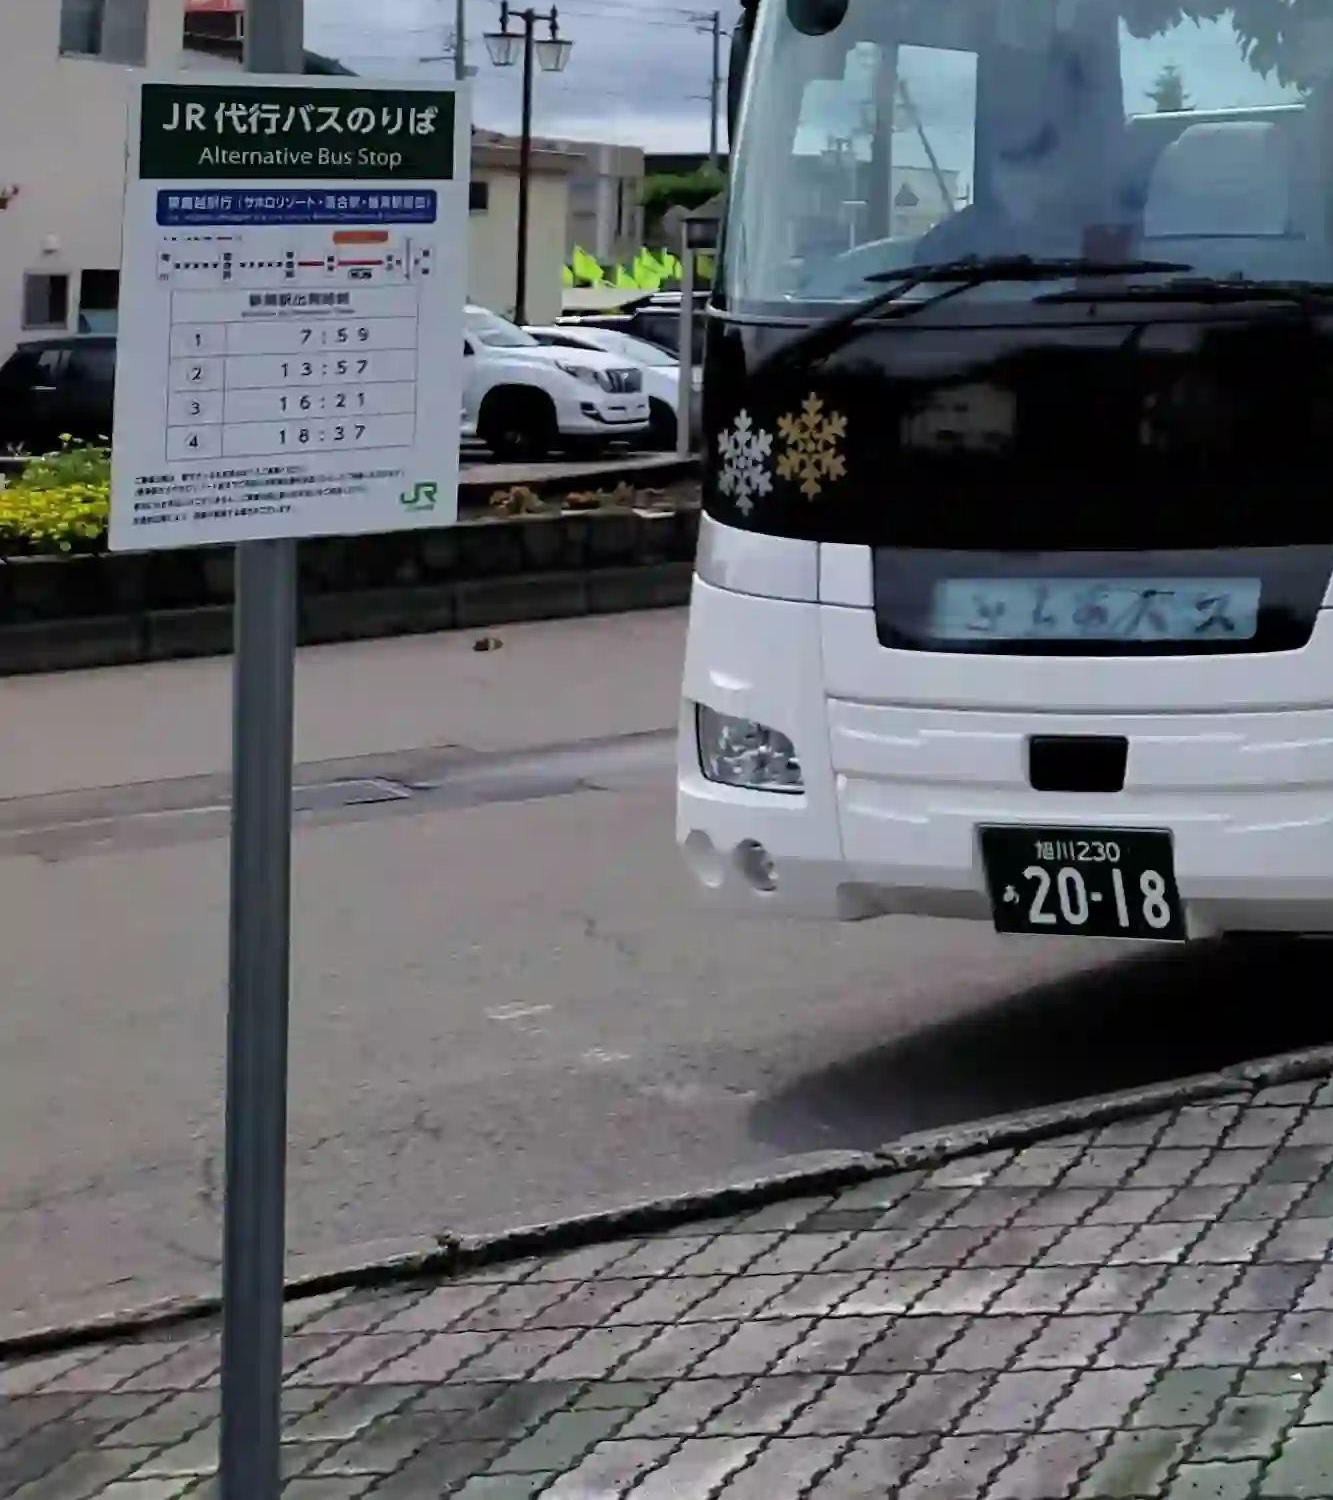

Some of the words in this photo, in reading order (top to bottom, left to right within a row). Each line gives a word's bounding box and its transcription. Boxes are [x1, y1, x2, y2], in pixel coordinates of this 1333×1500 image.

[162, 102, 439, 135] JR代行バスのりば
[198, 146, 314, 166] Alternative
[318, 147, 352, 166] Bus
[358, 147, 402, 171] Stop
[1003, 884, 1020, 904] あ
[1022, 865, 1170, 929] 20-18
